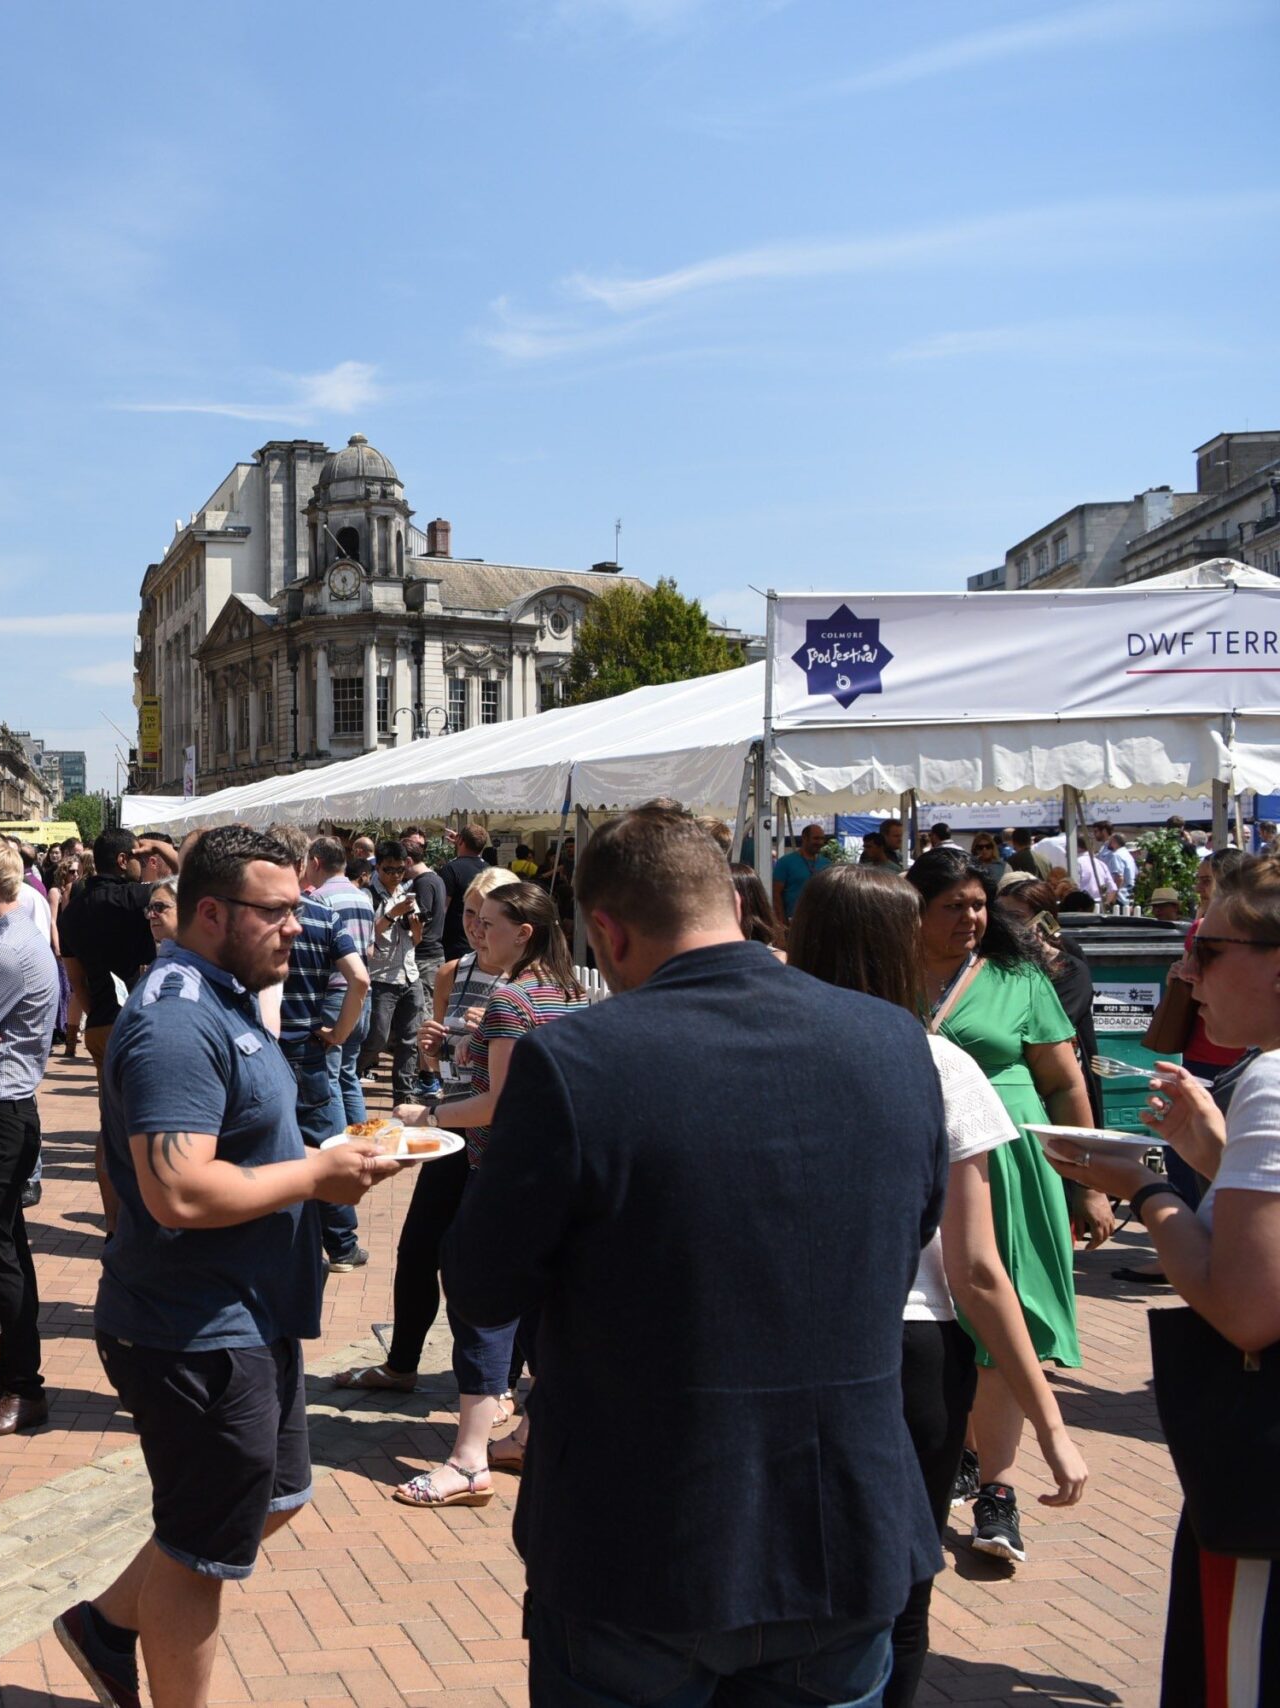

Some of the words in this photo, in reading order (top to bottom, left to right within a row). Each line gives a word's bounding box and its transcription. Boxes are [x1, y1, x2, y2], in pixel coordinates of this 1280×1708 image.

[807, 648, 831, 670] Food
[831, 643, 877, 668] Festival
[1127, 632, 1194, 657] DWF
[1206, 631, 1279, 655] TERR
